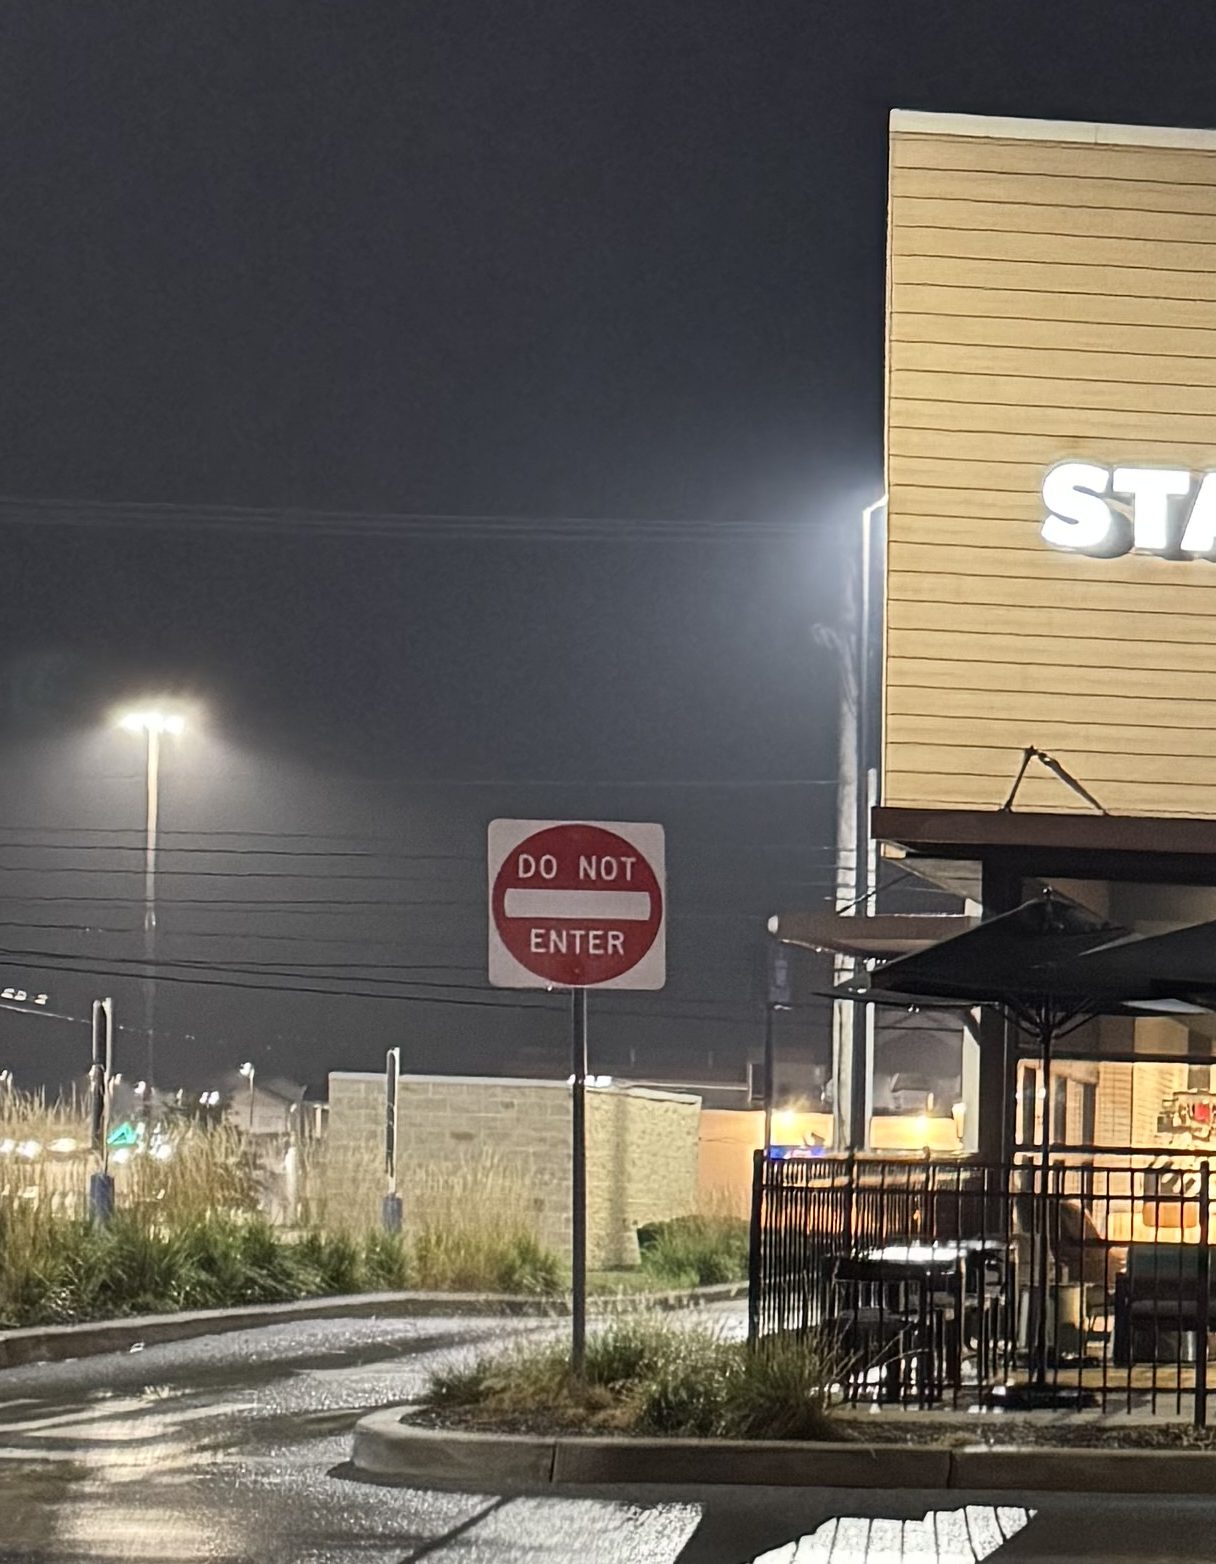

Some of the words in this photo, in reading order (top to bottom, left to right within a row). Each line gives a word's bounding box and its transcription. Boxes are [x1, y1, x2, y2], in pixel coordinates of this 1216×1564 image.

[518, 854, 557, 879] DO
[579, 855, 637, 881] NOT
[530, 928, 625, 956] ENTER
